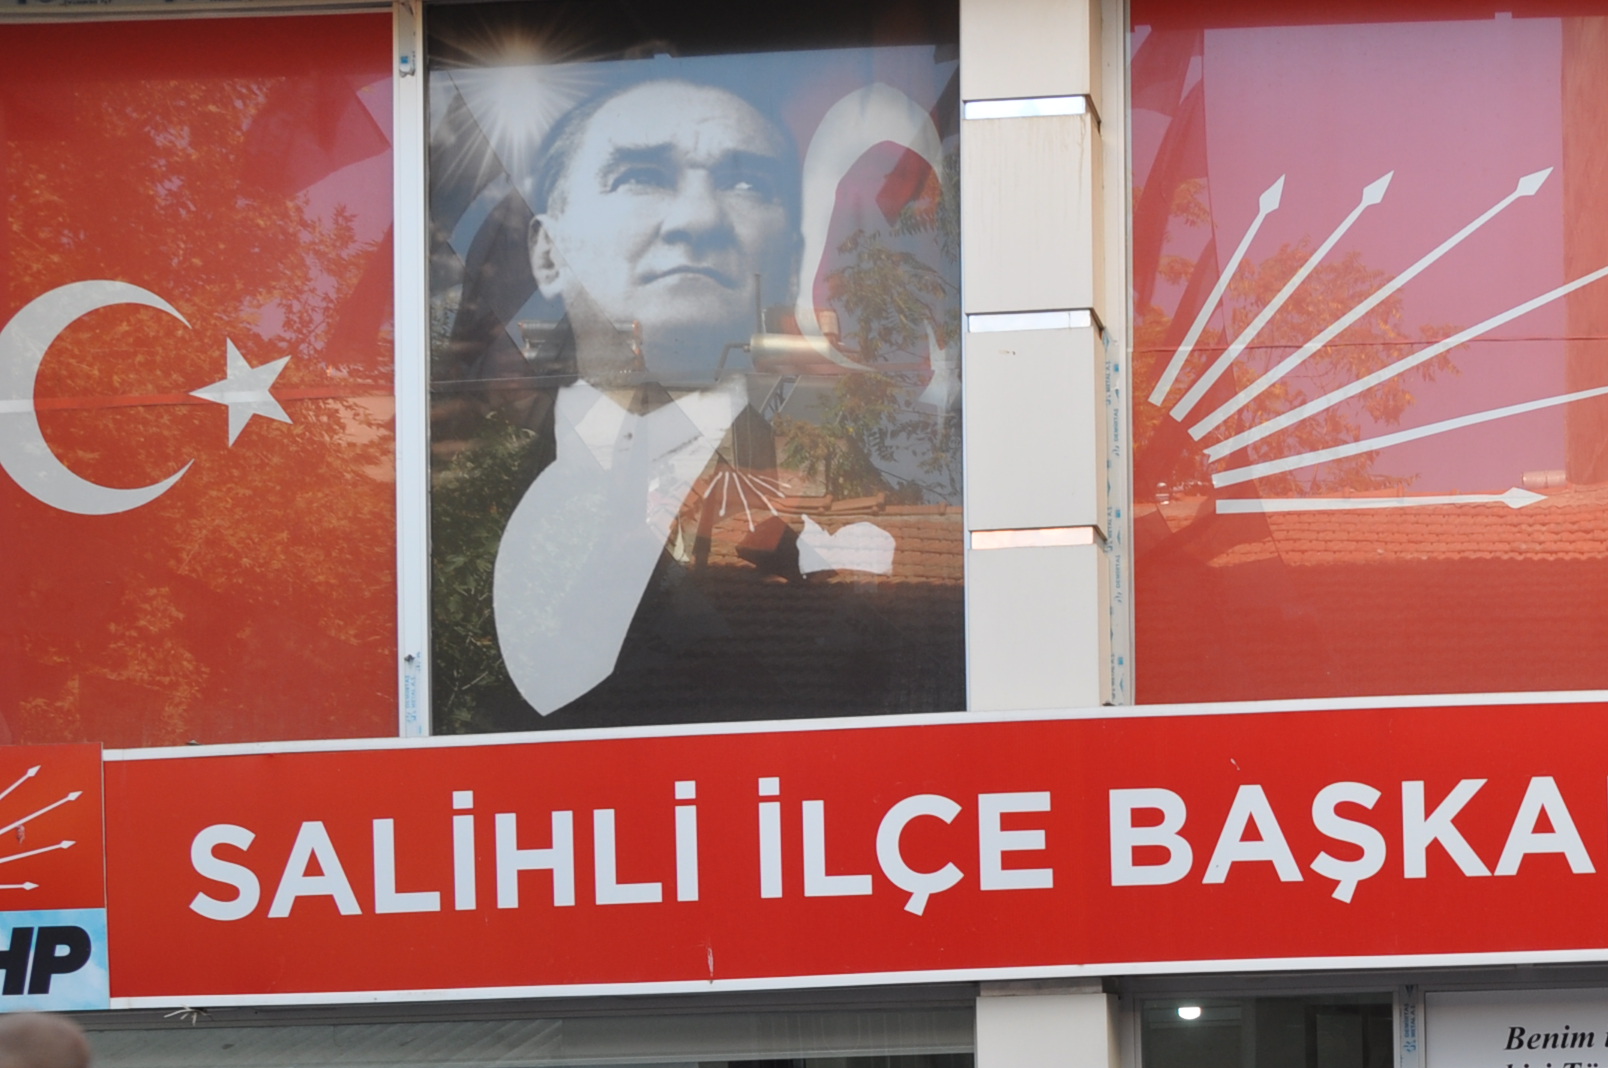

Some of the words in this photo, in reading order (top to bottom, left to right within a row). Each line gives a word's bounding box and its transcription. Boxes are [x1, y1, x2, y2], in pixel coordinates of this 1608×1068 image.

[189, 780, 698, 921] SALİHLİ
[758, 777, 1053, 916] İLÇE
[0, 926, 91, 996] HP
[1504, 1025, 1595, 1050] Benim
